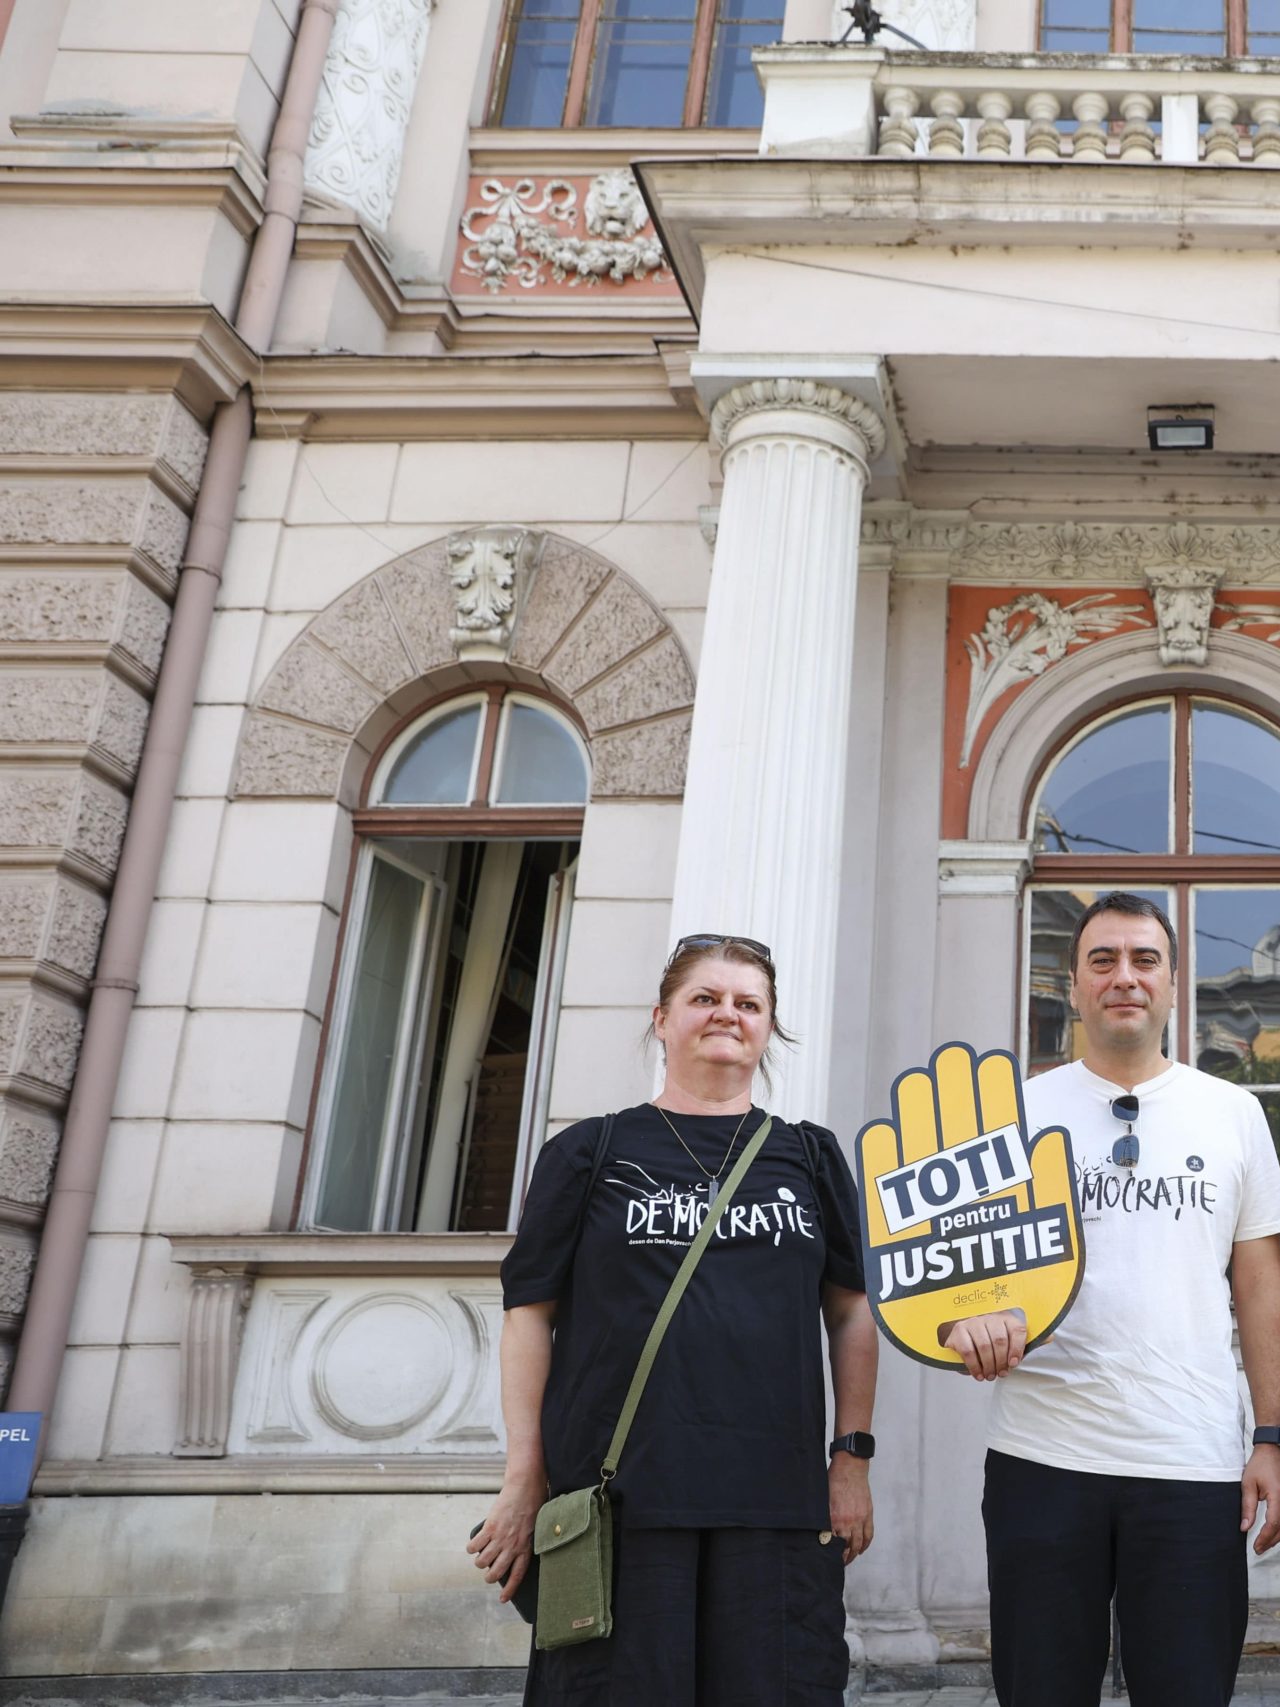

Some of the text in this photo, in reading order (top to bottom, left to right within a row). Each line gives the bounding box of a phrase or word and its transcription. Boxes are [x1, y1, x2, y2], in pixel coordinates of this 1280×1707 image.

[881, 1134, 1016, 1220] TOȚI
[1081, 1173, 1218, 1221] MOCRAȚIE
[939, 1202, 1011, 1236] pentru
[879, 1217, 1065, 1301] JUSTIȚIE
[953, 1289, 987, 1305] declic
[0, 1428, 31, 1442] PEL
